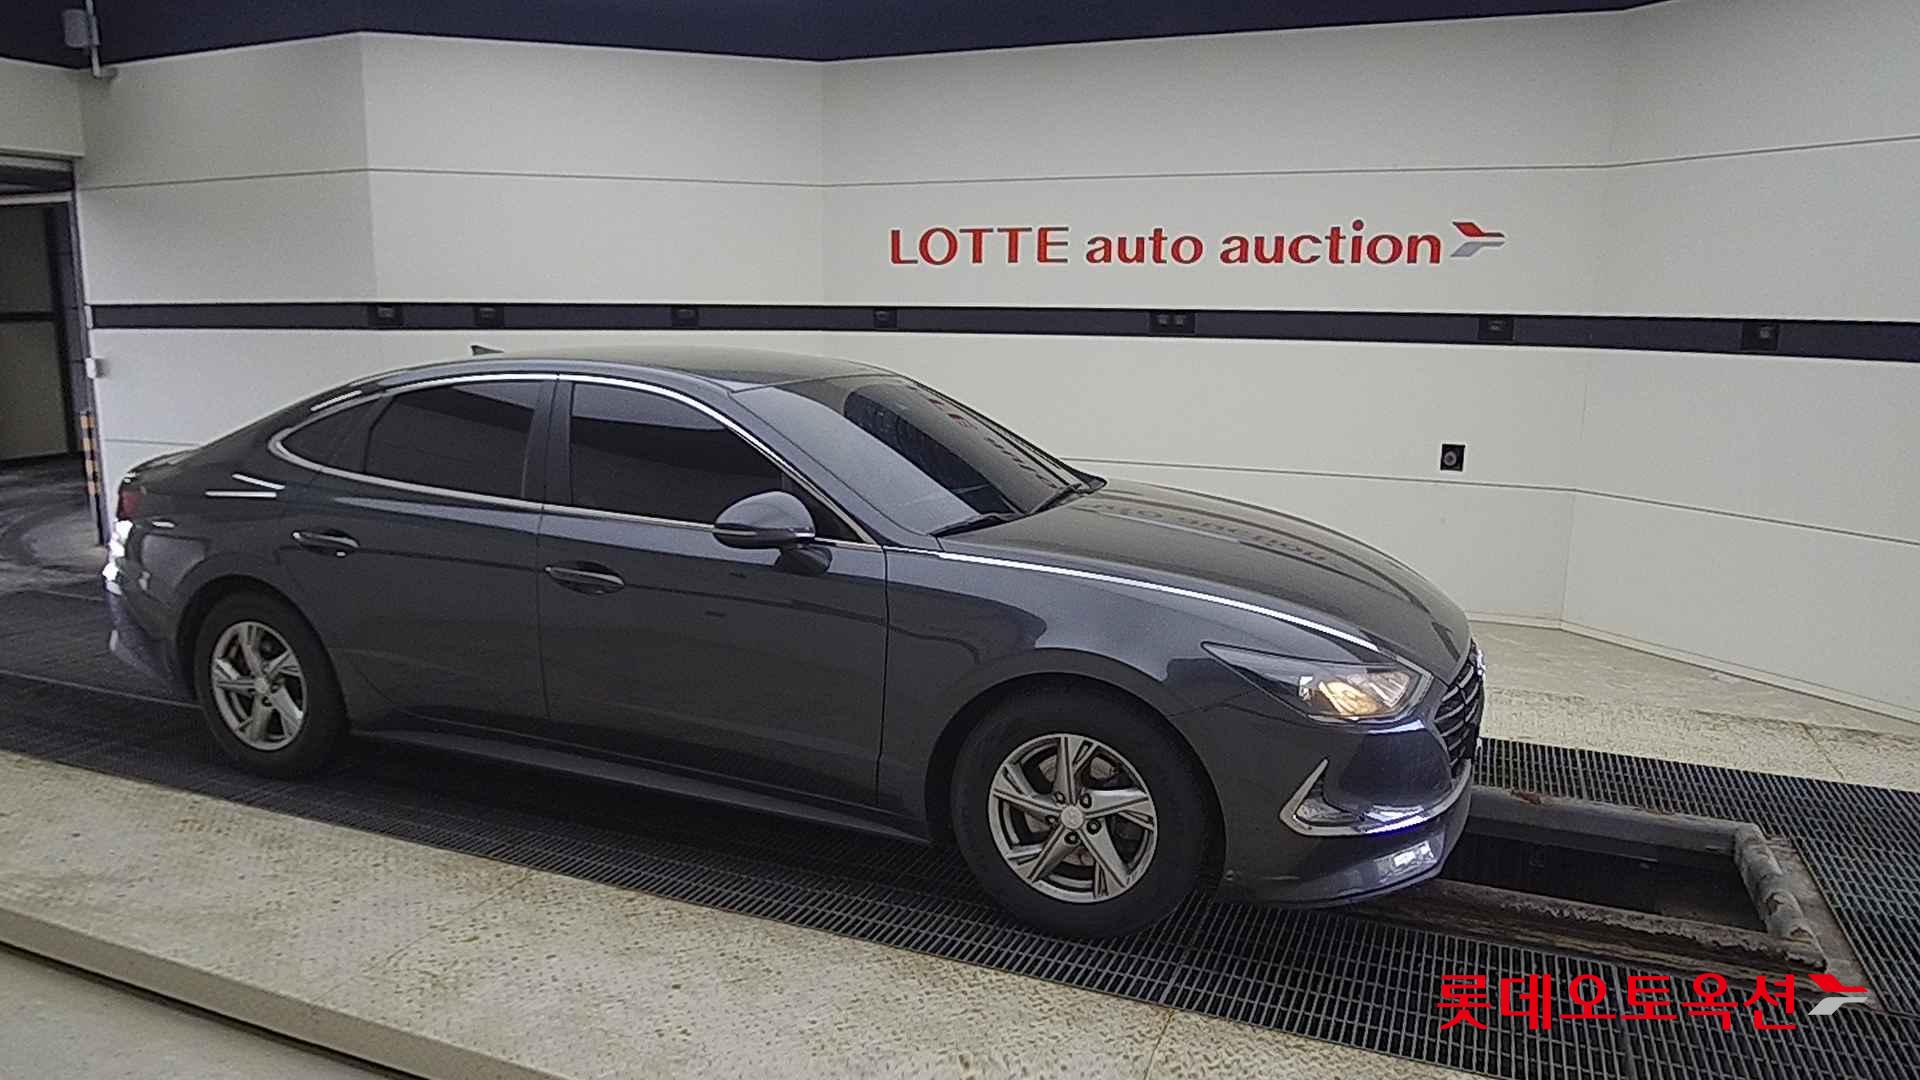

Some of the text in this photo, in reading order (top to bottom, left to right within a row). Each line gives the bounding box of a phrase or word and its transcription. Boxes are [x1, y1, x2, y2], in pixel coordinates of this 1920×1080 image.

[889, 220, 1442, 267] LOTTE auto auction
